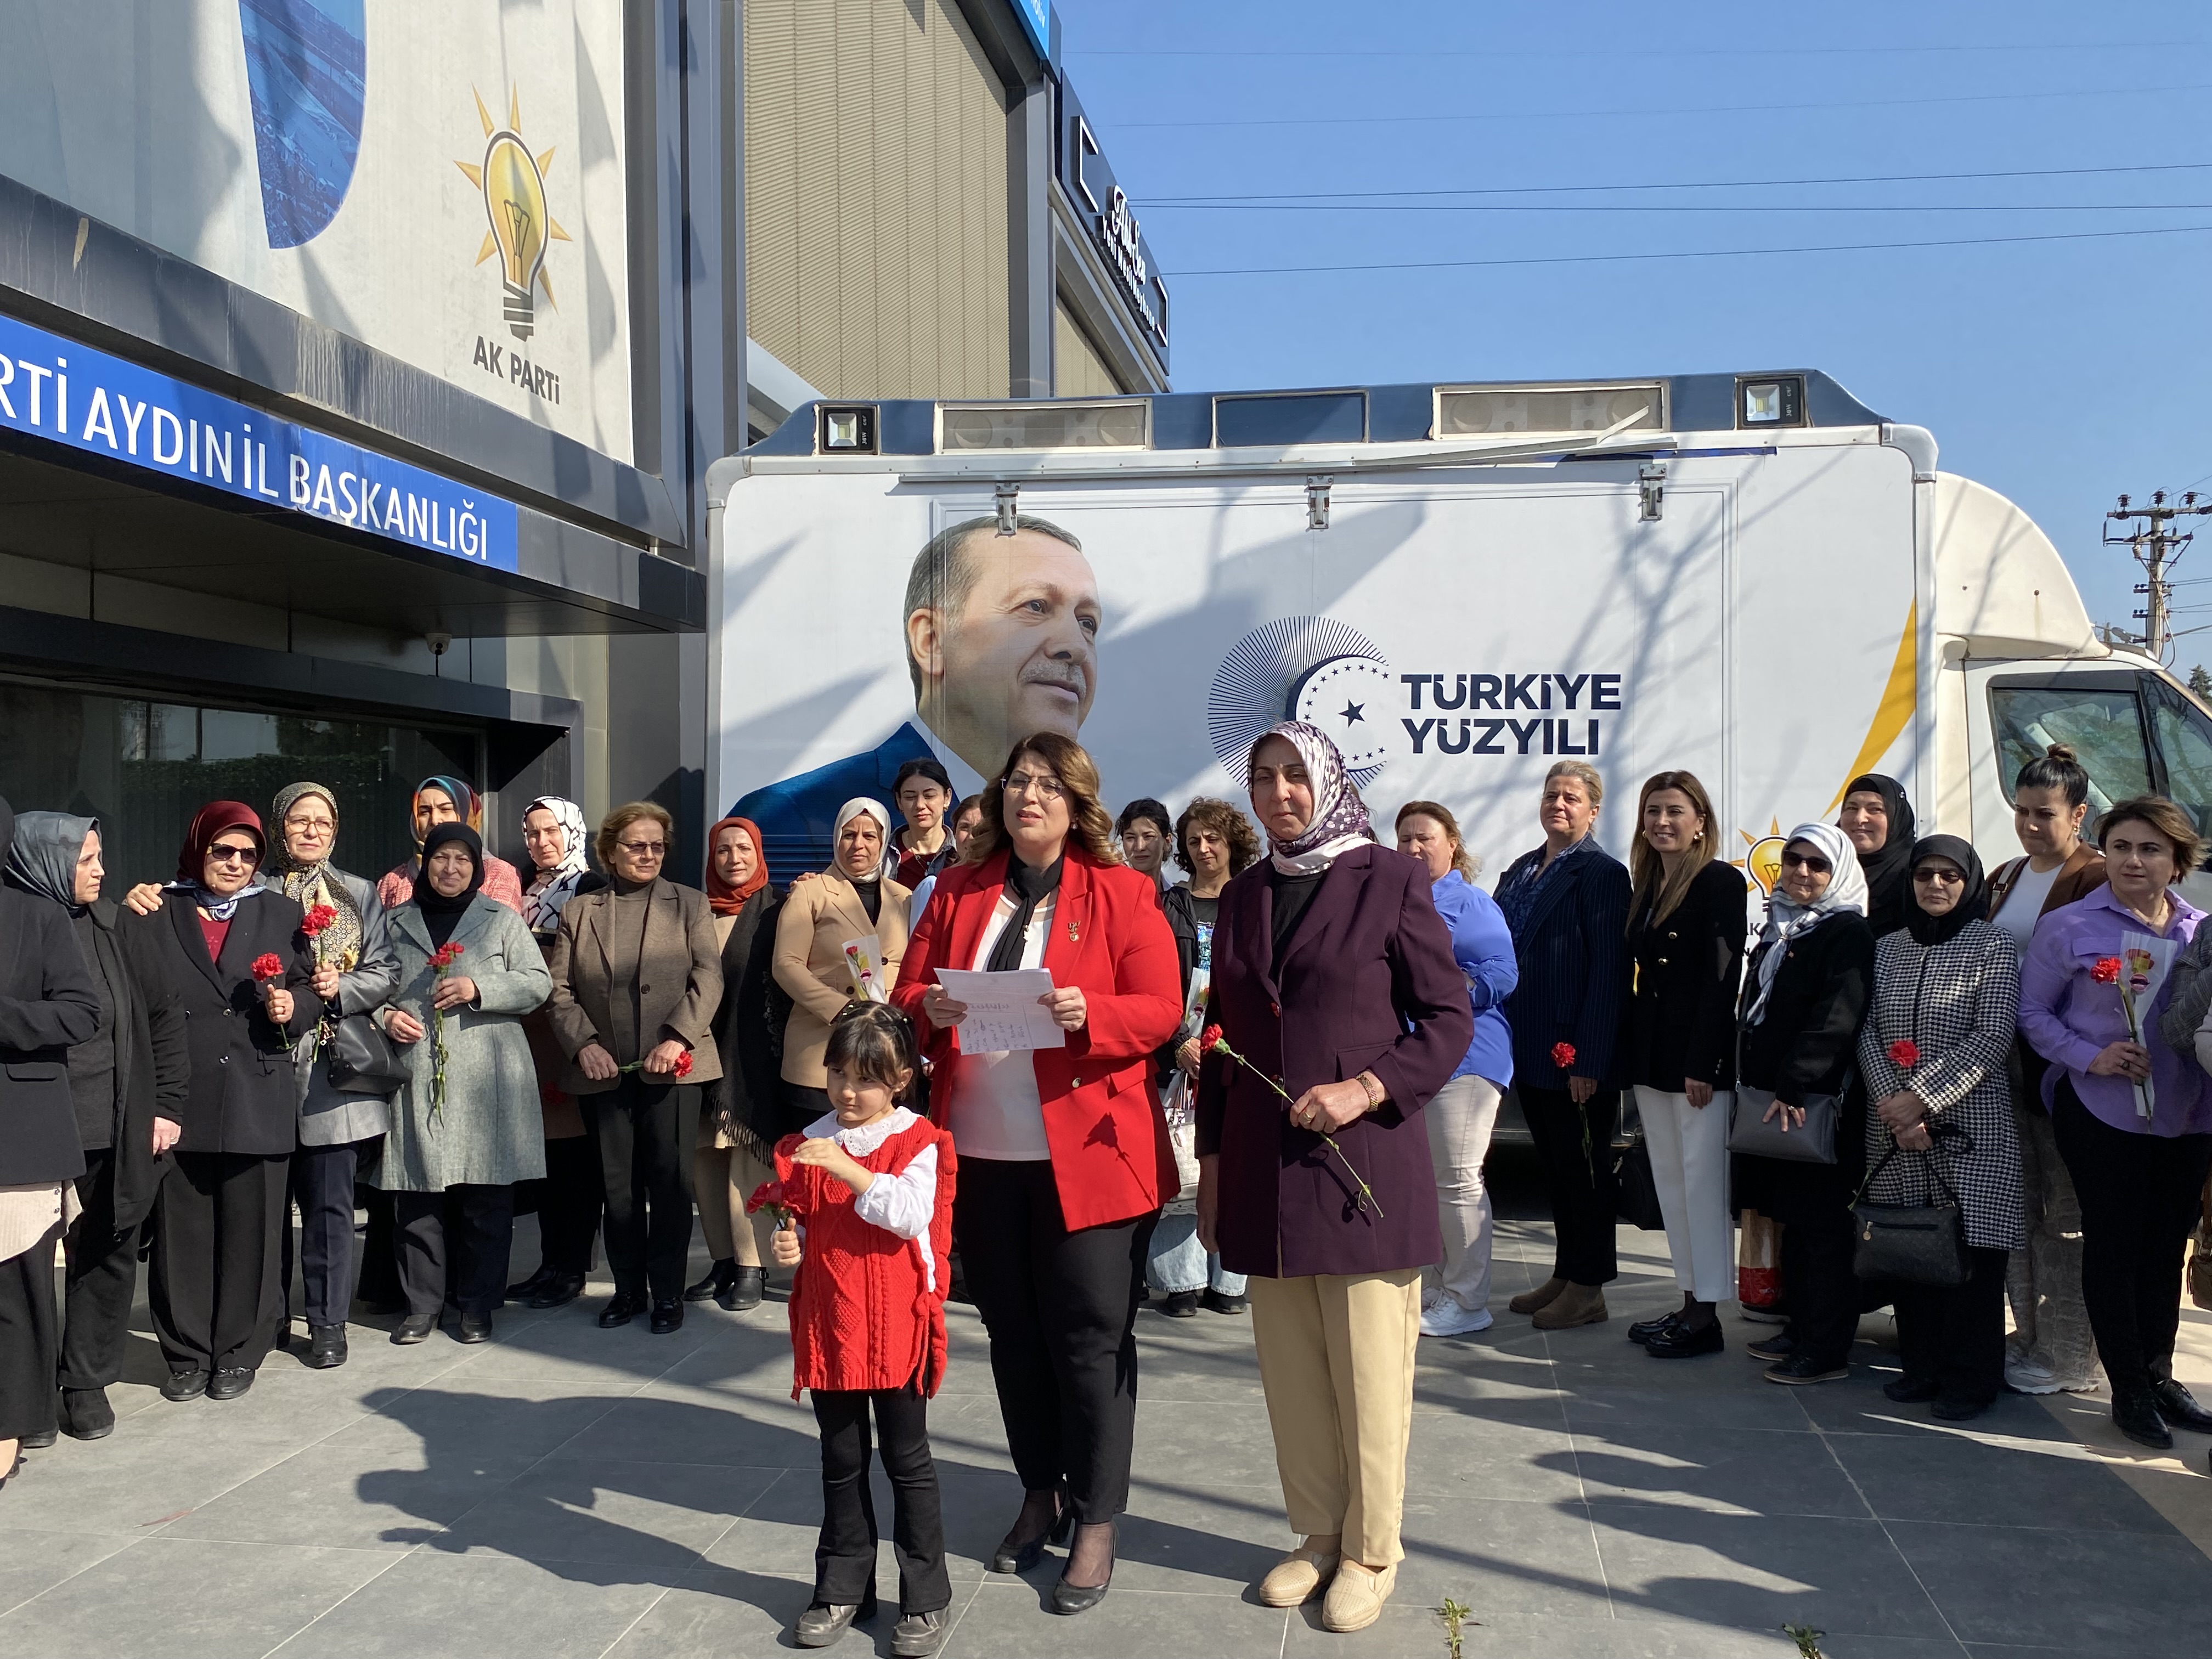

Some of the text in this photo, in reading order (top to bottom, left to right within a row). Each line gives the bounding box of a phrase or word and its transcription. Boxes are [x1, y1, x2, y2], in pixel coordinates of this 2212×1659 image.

[1103, 215, 1117, 261] Yeni
[1133, 274, 1155, 331] Meyhane
[473, 335, 504, 379] AK
[83, 386, 232, 484] AYDIN
[244, 423, 279, 498] İL
[290, 453, 487, 561] BAŞKANLIĞI
[1400, 674, 1622, 710] TÜRKİYE
[1400, 718, 1599, 755] YÜZYILI
